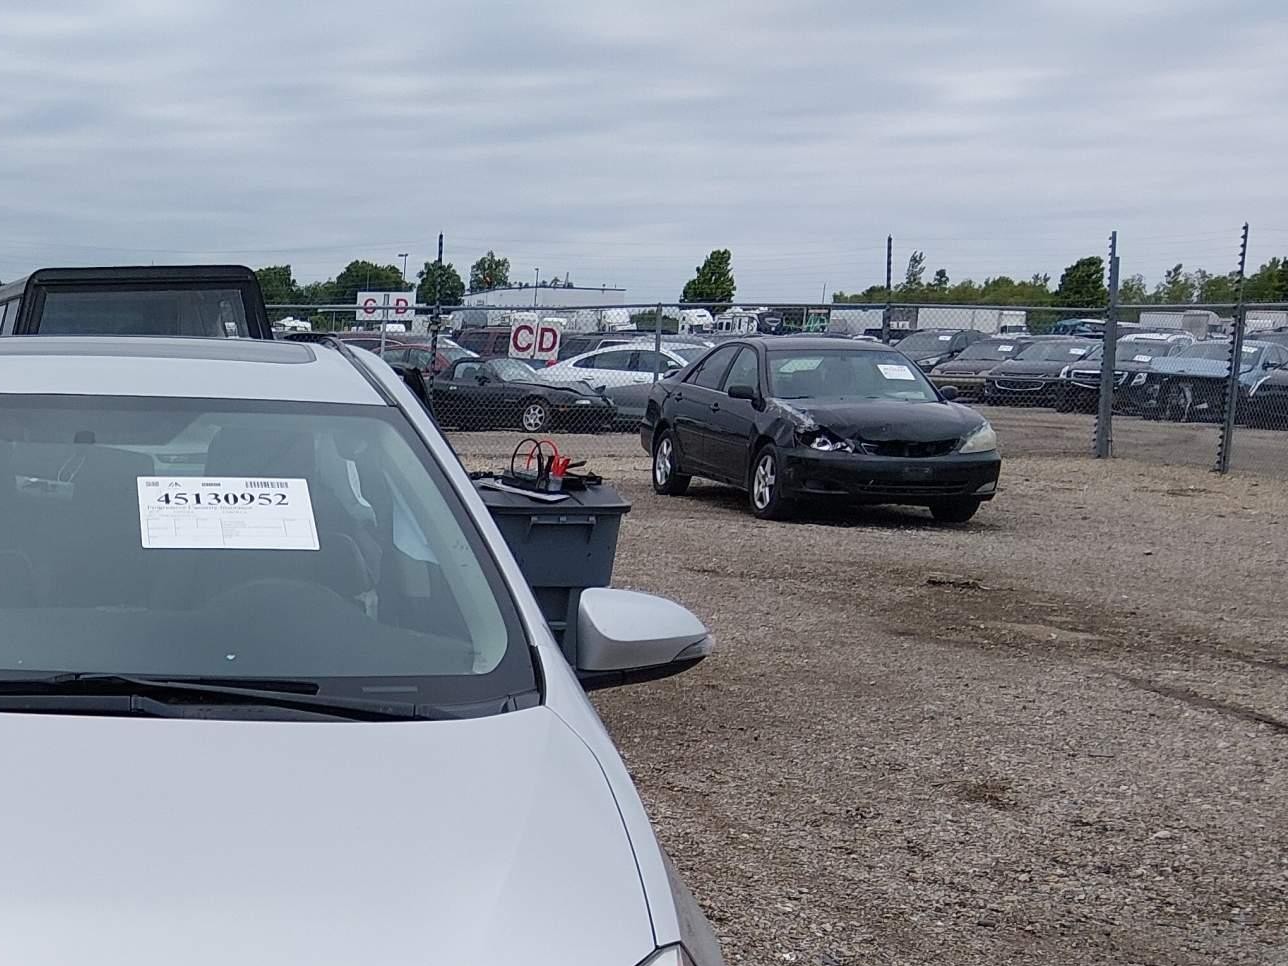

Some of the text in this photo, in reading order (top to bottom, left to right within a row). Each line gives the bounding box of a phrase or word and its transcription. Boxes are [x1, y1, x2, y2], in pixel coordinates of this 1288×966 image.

[363, 298, 409, 314] C D
[512, 324, 558, 352] C D
[157, 492, 289, 506] 45130952
